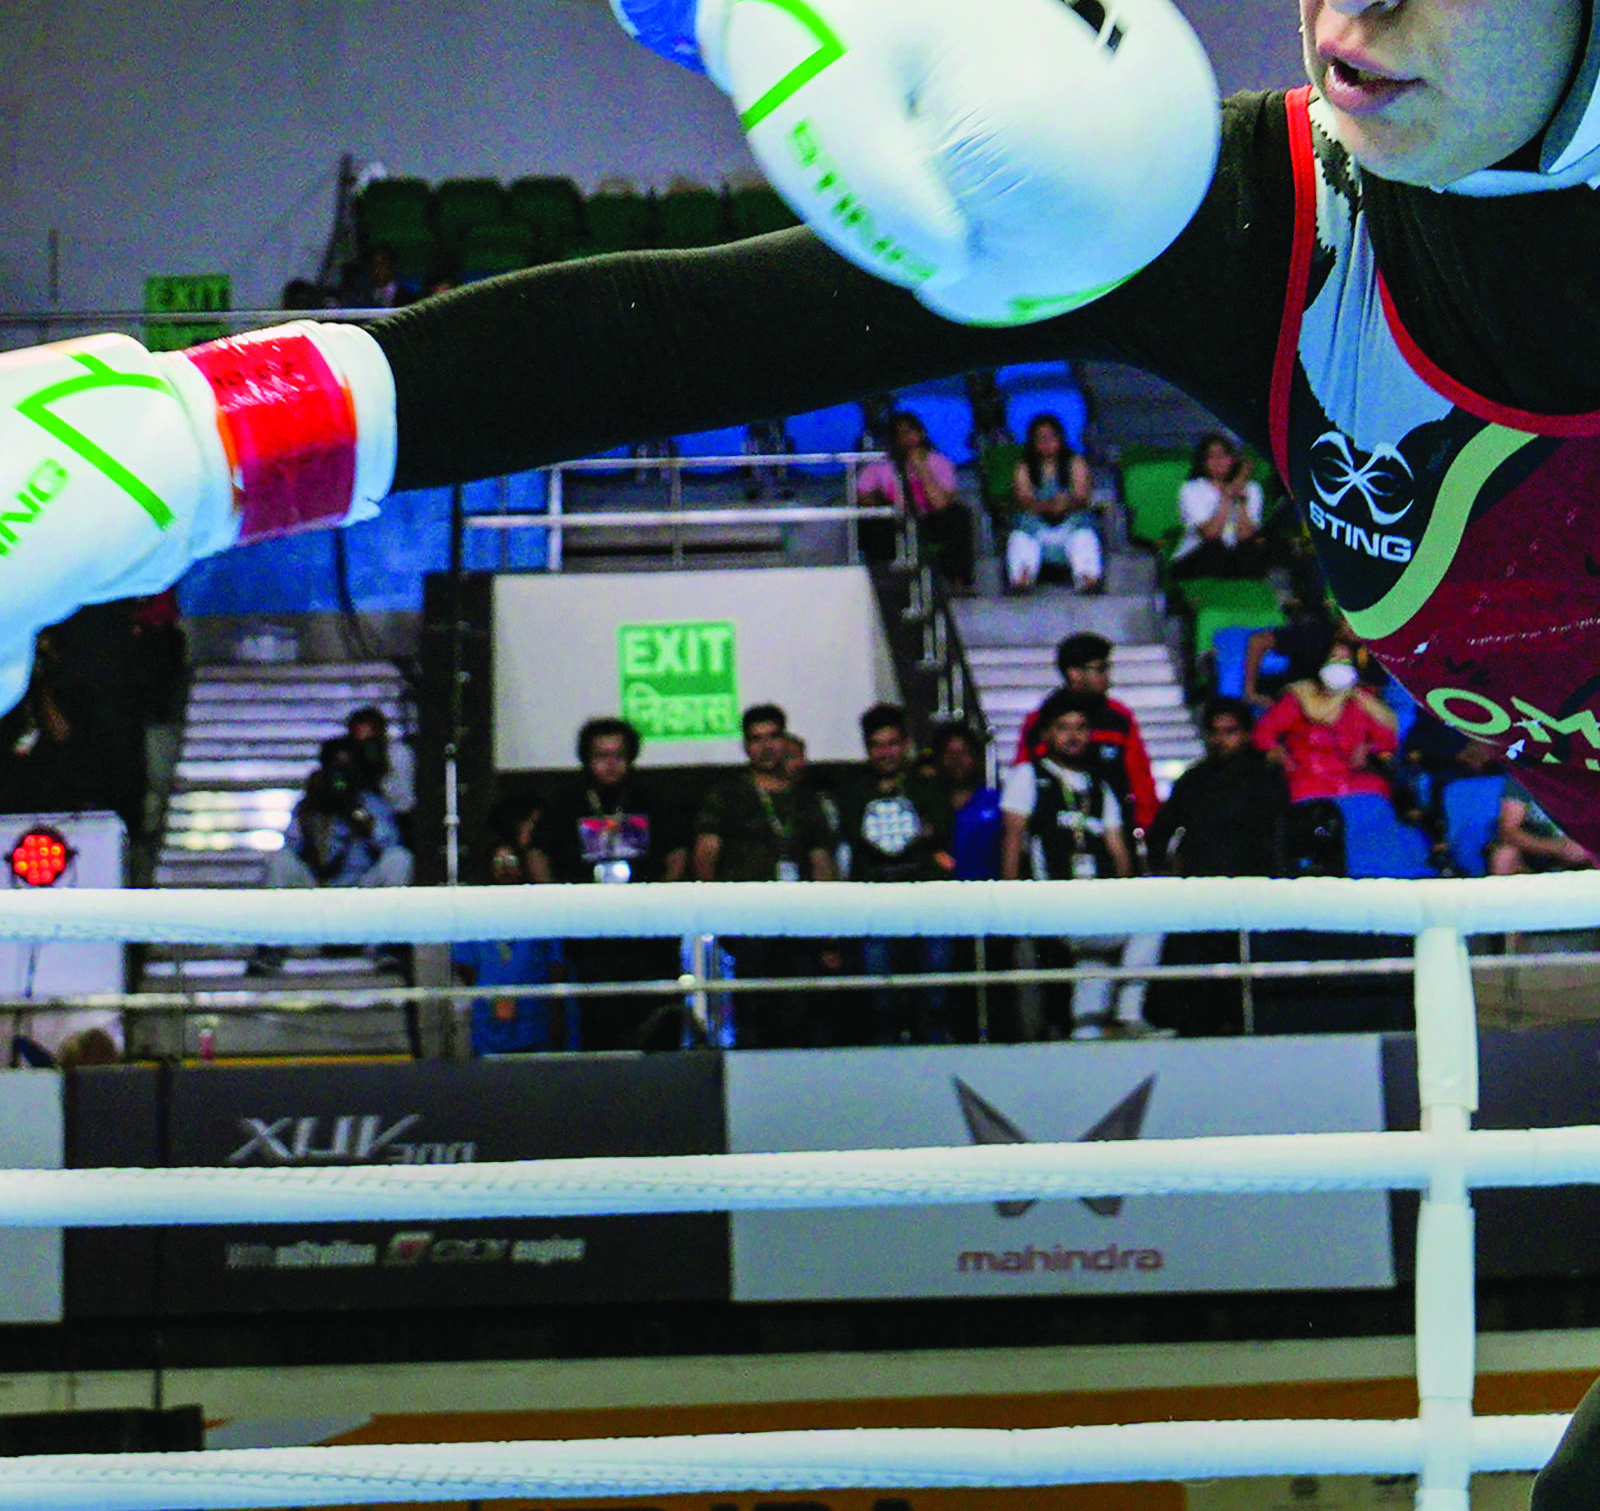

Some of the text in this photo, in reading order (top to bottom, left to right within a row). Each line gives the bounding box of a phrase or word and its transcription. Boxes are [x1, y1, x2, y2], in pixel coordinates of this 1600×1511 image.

[1310, 501, 1411, 563] STING
[625, 629, 731, 673] EXIT
[956, 1241, 1164, 1274] mahindra
